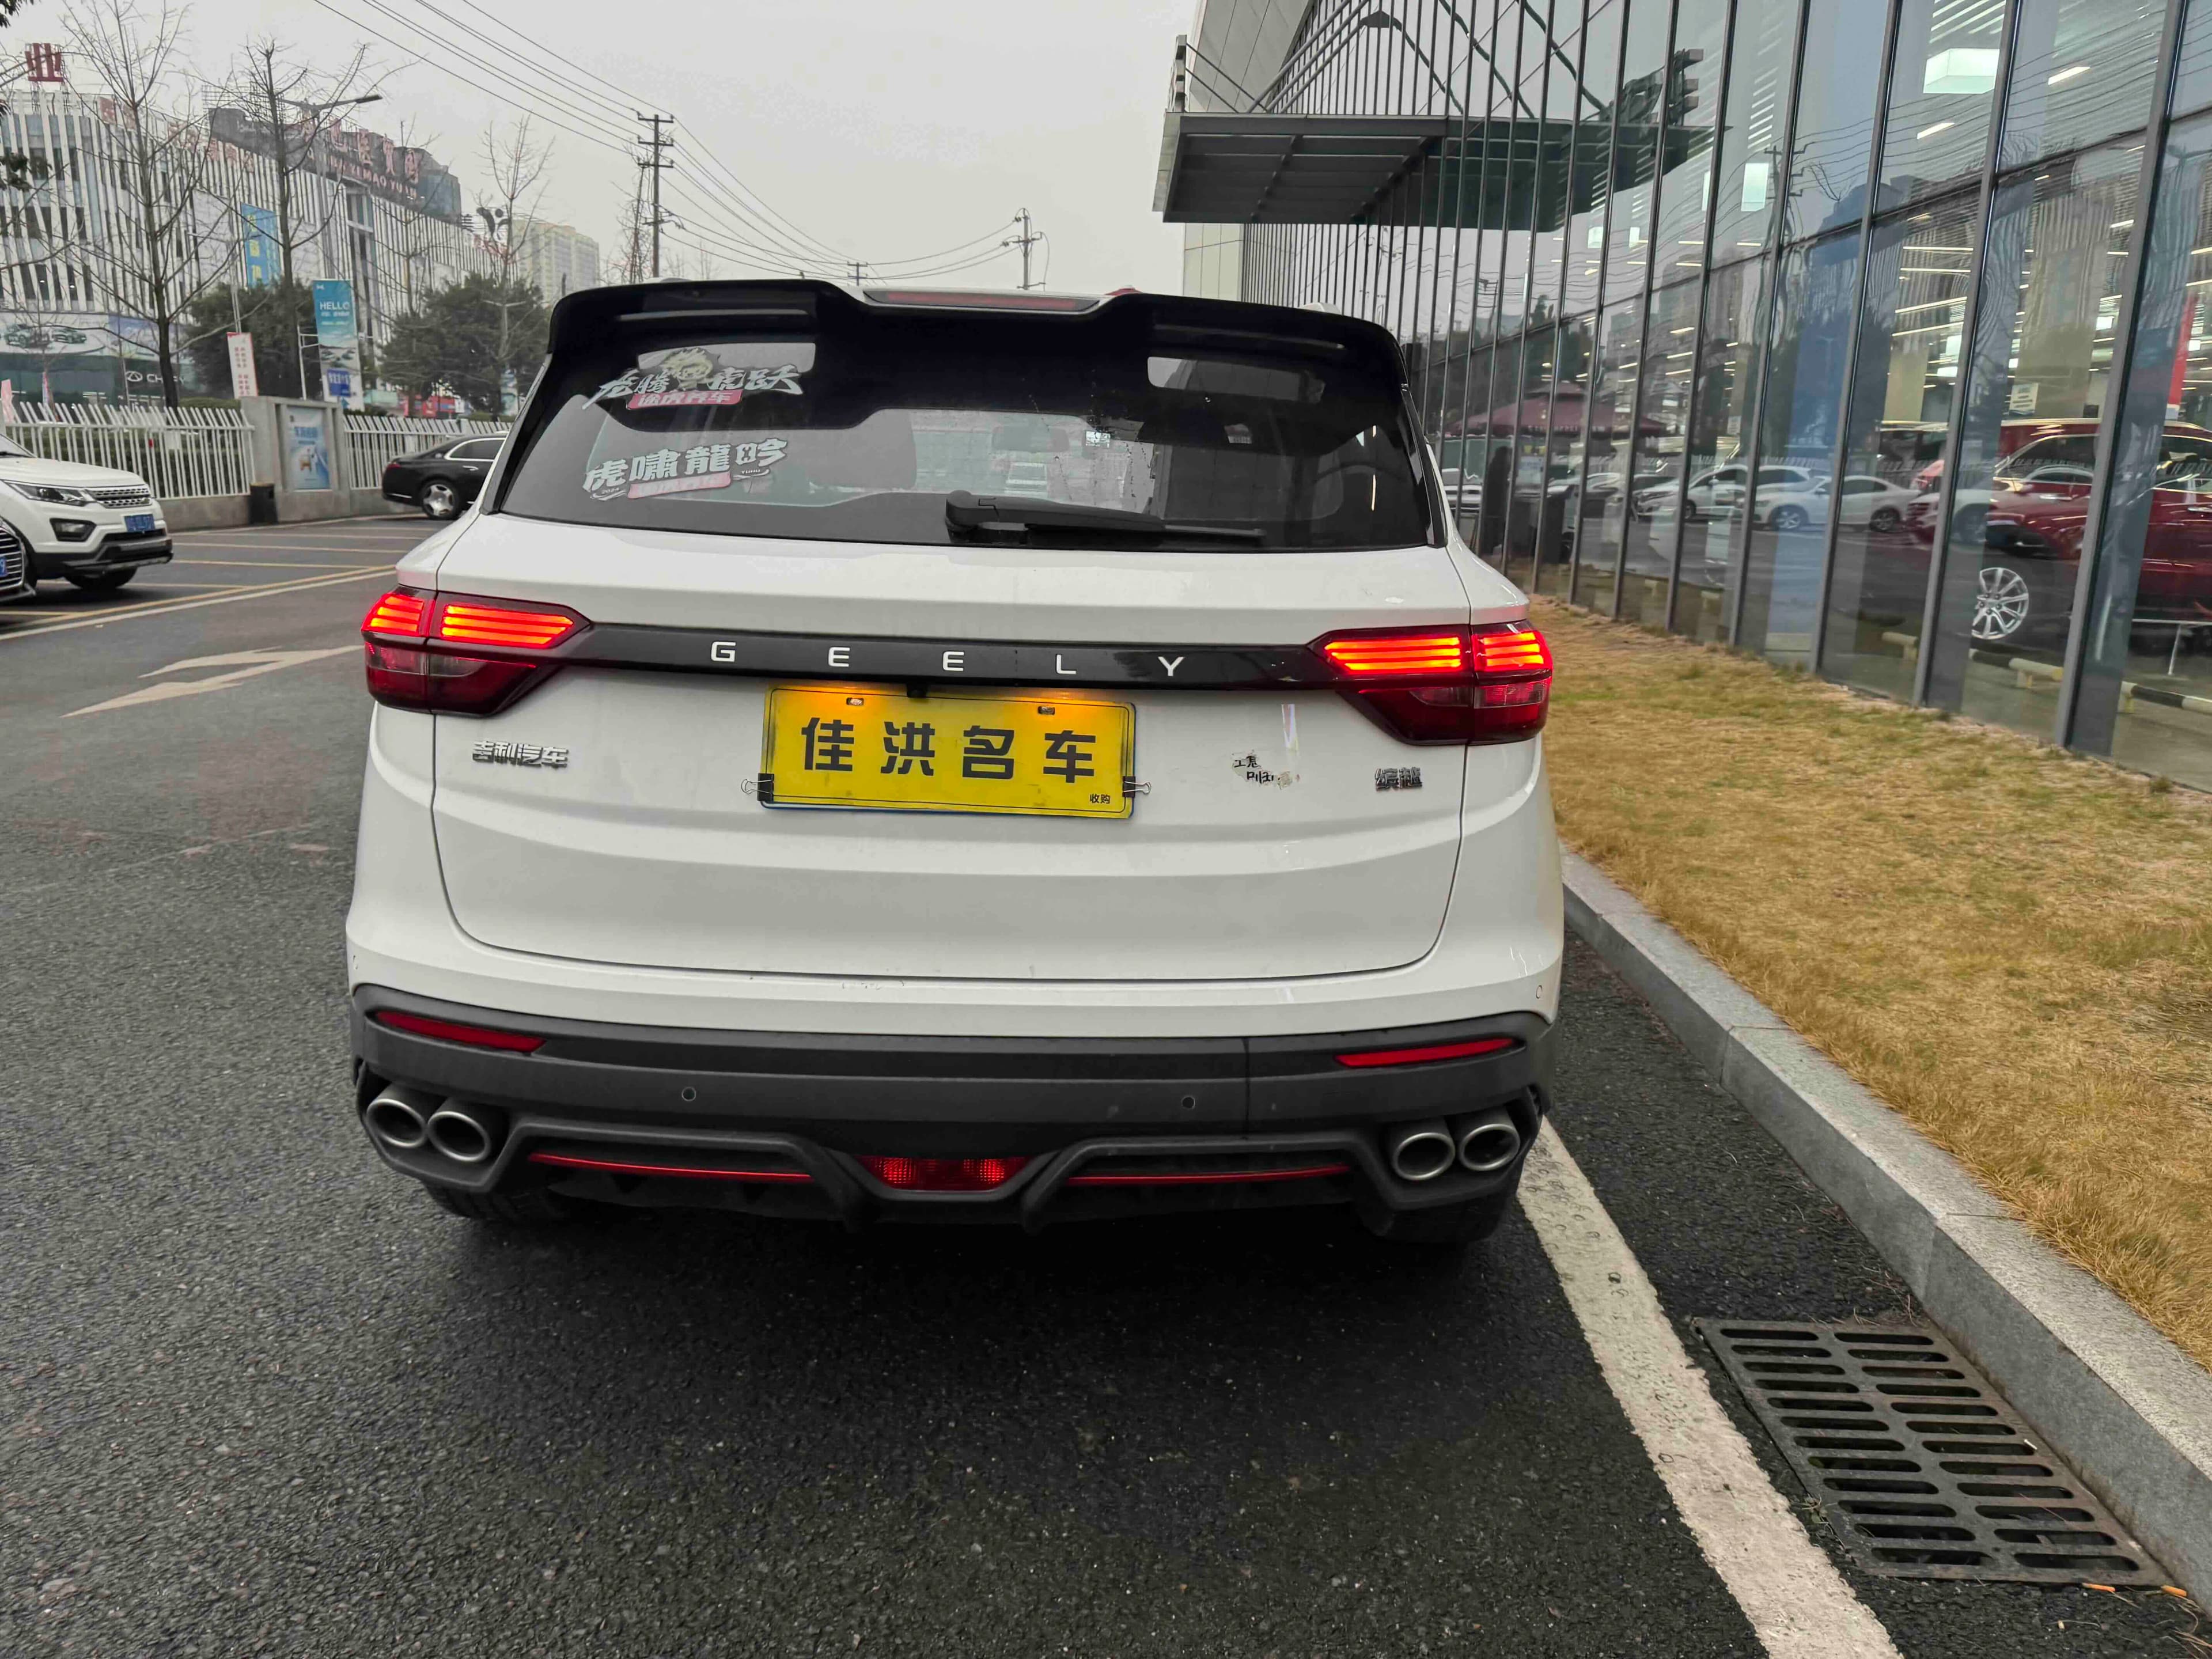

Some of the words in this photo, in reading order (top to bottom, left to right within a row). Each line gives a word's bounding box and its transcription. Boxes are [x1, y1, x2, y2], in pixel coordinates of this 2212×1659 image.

[320, 301, 350, 310] HELLO
[147, 373, 185, 385] CHRY
[638, 390, 734, 407] 途虎养车
[711, 641, 1185, 676] GEELY
[472, 740, 569, 769] 吉利汽车
[801, 717, 1096, 783] 佳洪名车
[1089, 793, 1111, 804] 收购
